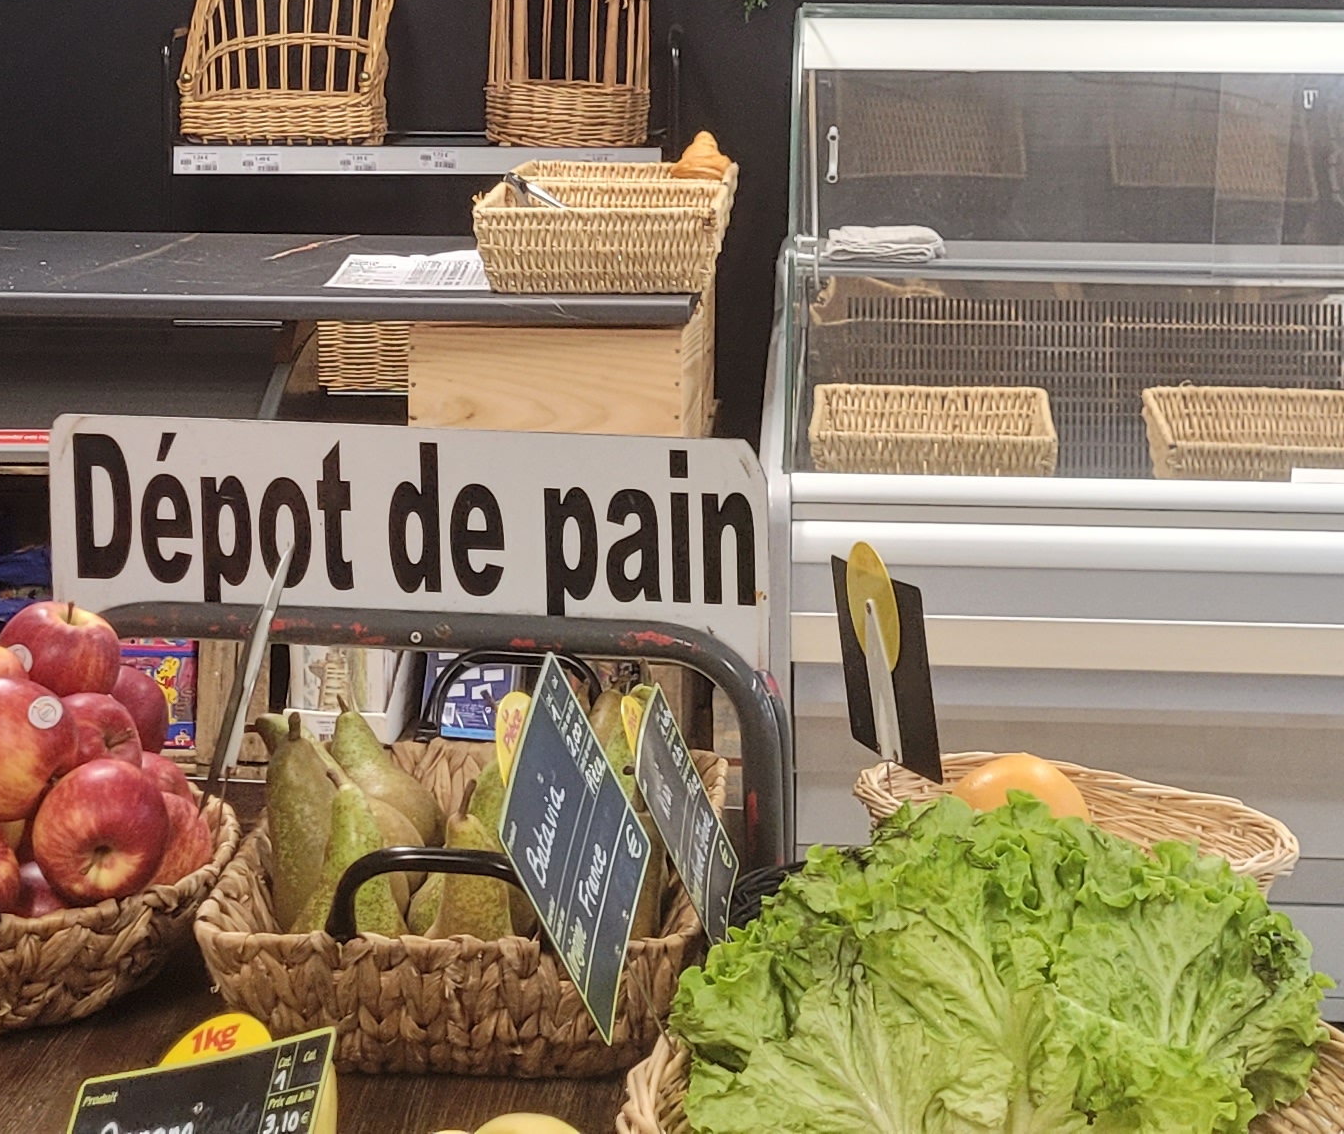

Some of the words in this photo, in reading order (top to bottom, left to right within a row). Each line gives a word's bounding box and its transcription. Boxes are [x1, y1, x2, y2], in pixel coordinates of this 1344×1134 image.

[72, 432, 355, 602] Dépot
[388, 443, 505, 597] de
[543, 450, 757, 616] pain
[549, 704, 561, 723] 1
[525, 785, 565, 888] Batavia
[625, 823, 643, 859] €
[578, 843, 607, 917] France
[192, 1023, 241, 1054] 1kg
[274, 1070, 286, 1091] 1
[81, 1091, 119, 1108] Produit
